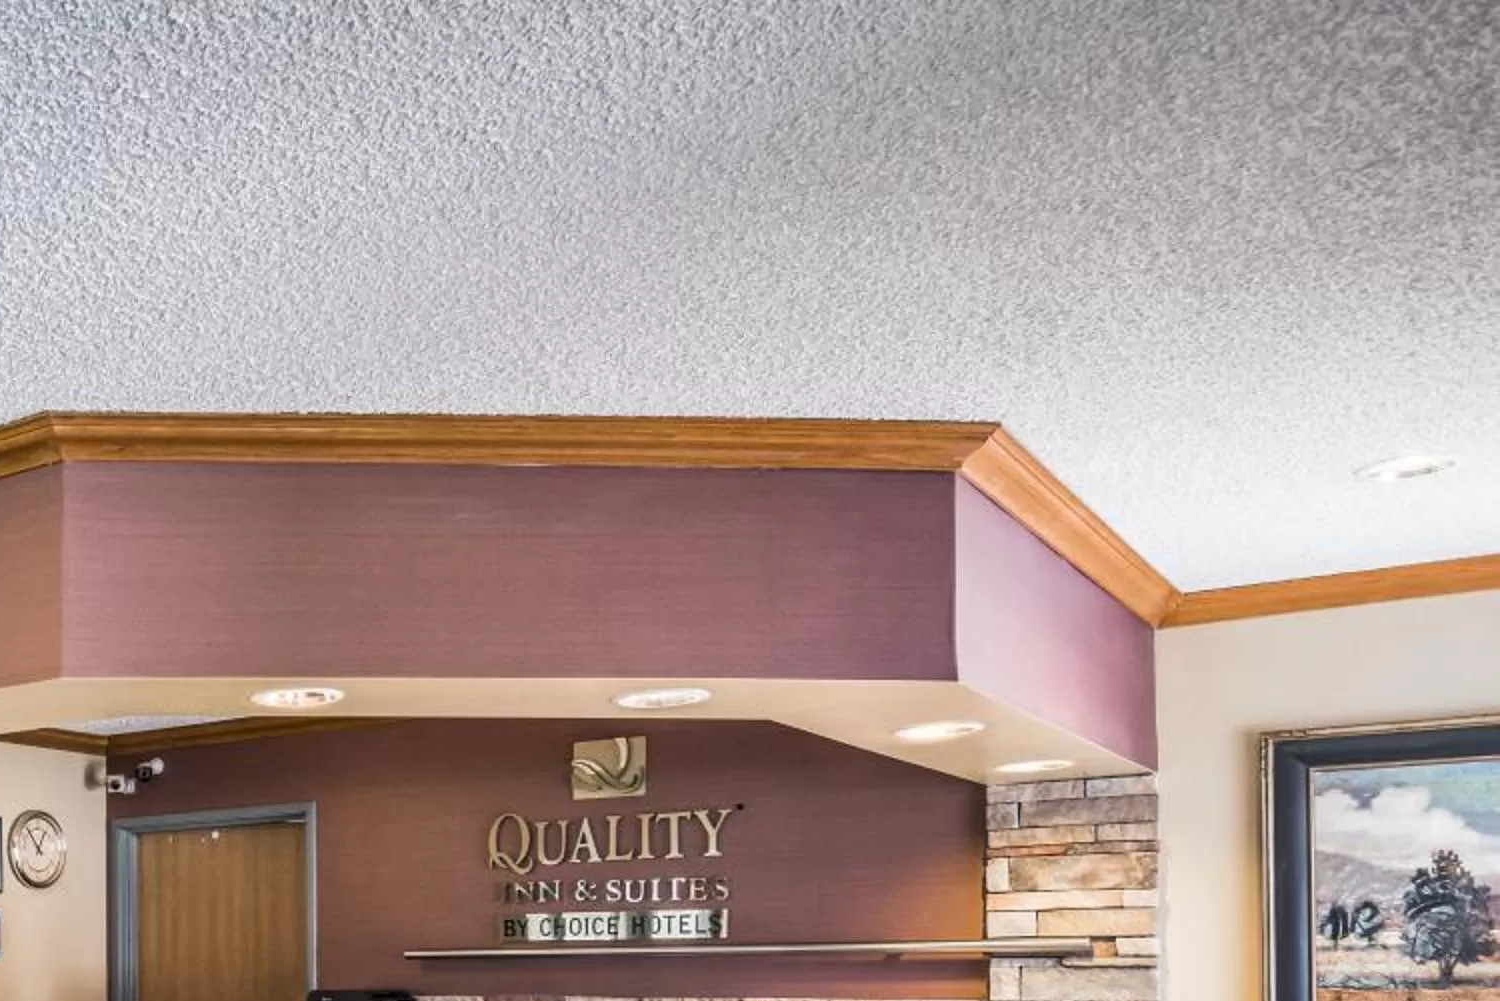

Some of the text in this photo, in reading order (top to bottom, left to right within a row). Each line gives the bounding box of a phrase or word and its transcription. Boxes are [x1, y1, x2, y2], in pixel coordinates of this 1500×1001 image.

[488, 808, 732, 874] QUALITY
[504, 876, 730, 903] INN & SUITES
[503, 913, 723, 938] BY CHOICE HOTELS
